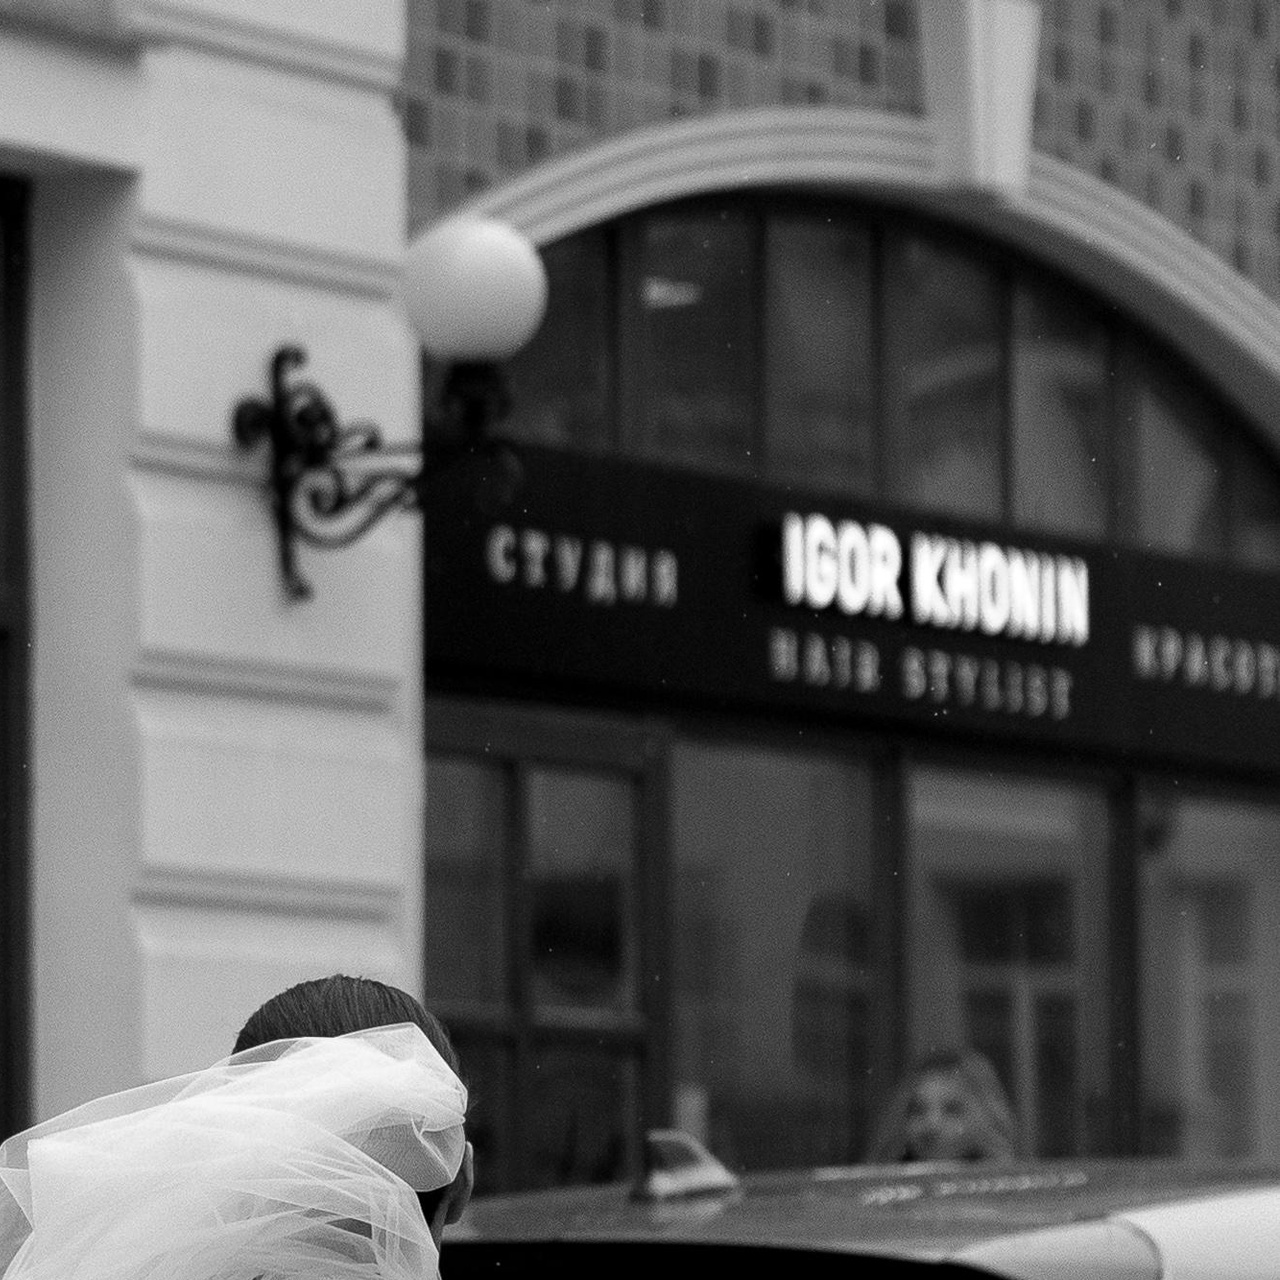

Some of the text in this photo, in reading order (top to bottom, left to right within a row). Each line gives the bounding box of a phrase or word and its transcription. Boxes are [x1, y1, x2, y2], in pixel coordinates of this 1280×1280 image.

[782, 511, 1092, 648] IGOR KHONIN
[769, 626, 1072, 720] HAIR STYLIST
[1131, 623, 1280, 700] КРАСОТ
